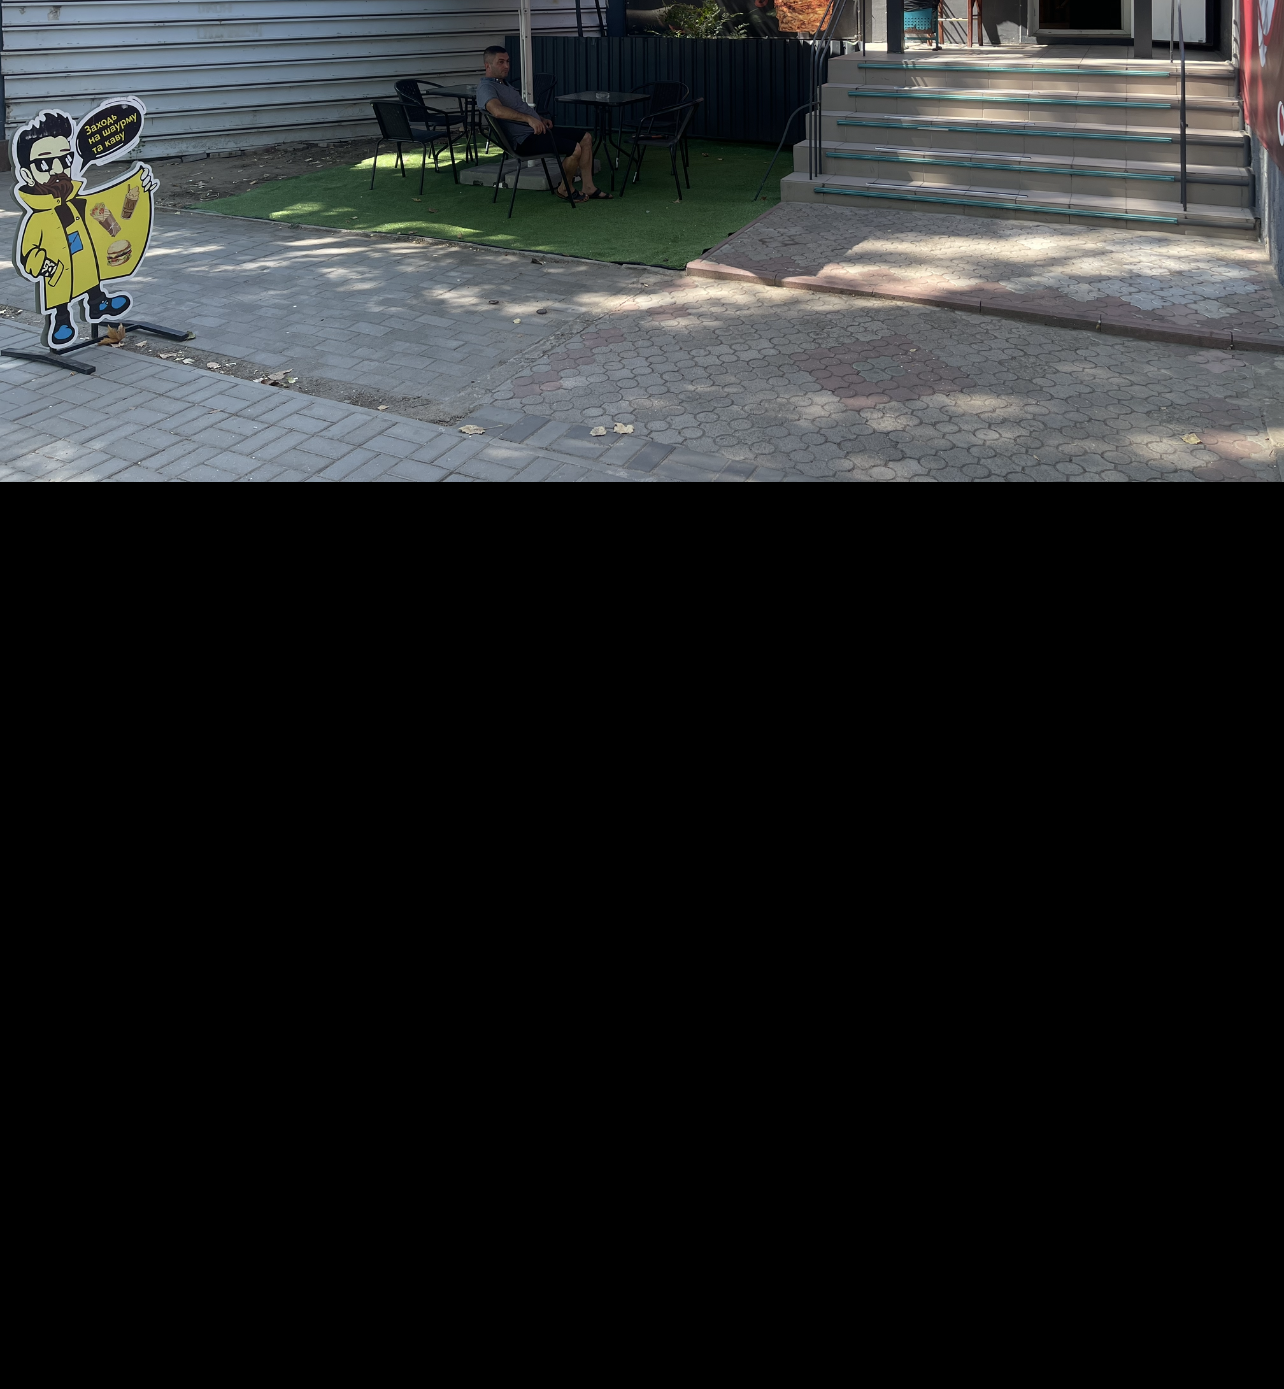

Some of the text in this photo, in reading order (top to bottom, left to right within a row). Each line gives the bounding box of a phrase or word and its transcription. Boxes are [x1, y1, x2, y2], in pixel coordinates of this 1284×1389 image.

[84, 114, 118, 136] Заходь
[88, 112, 137, 145] на шаурму
[92, 131, 125, 154] та каву
